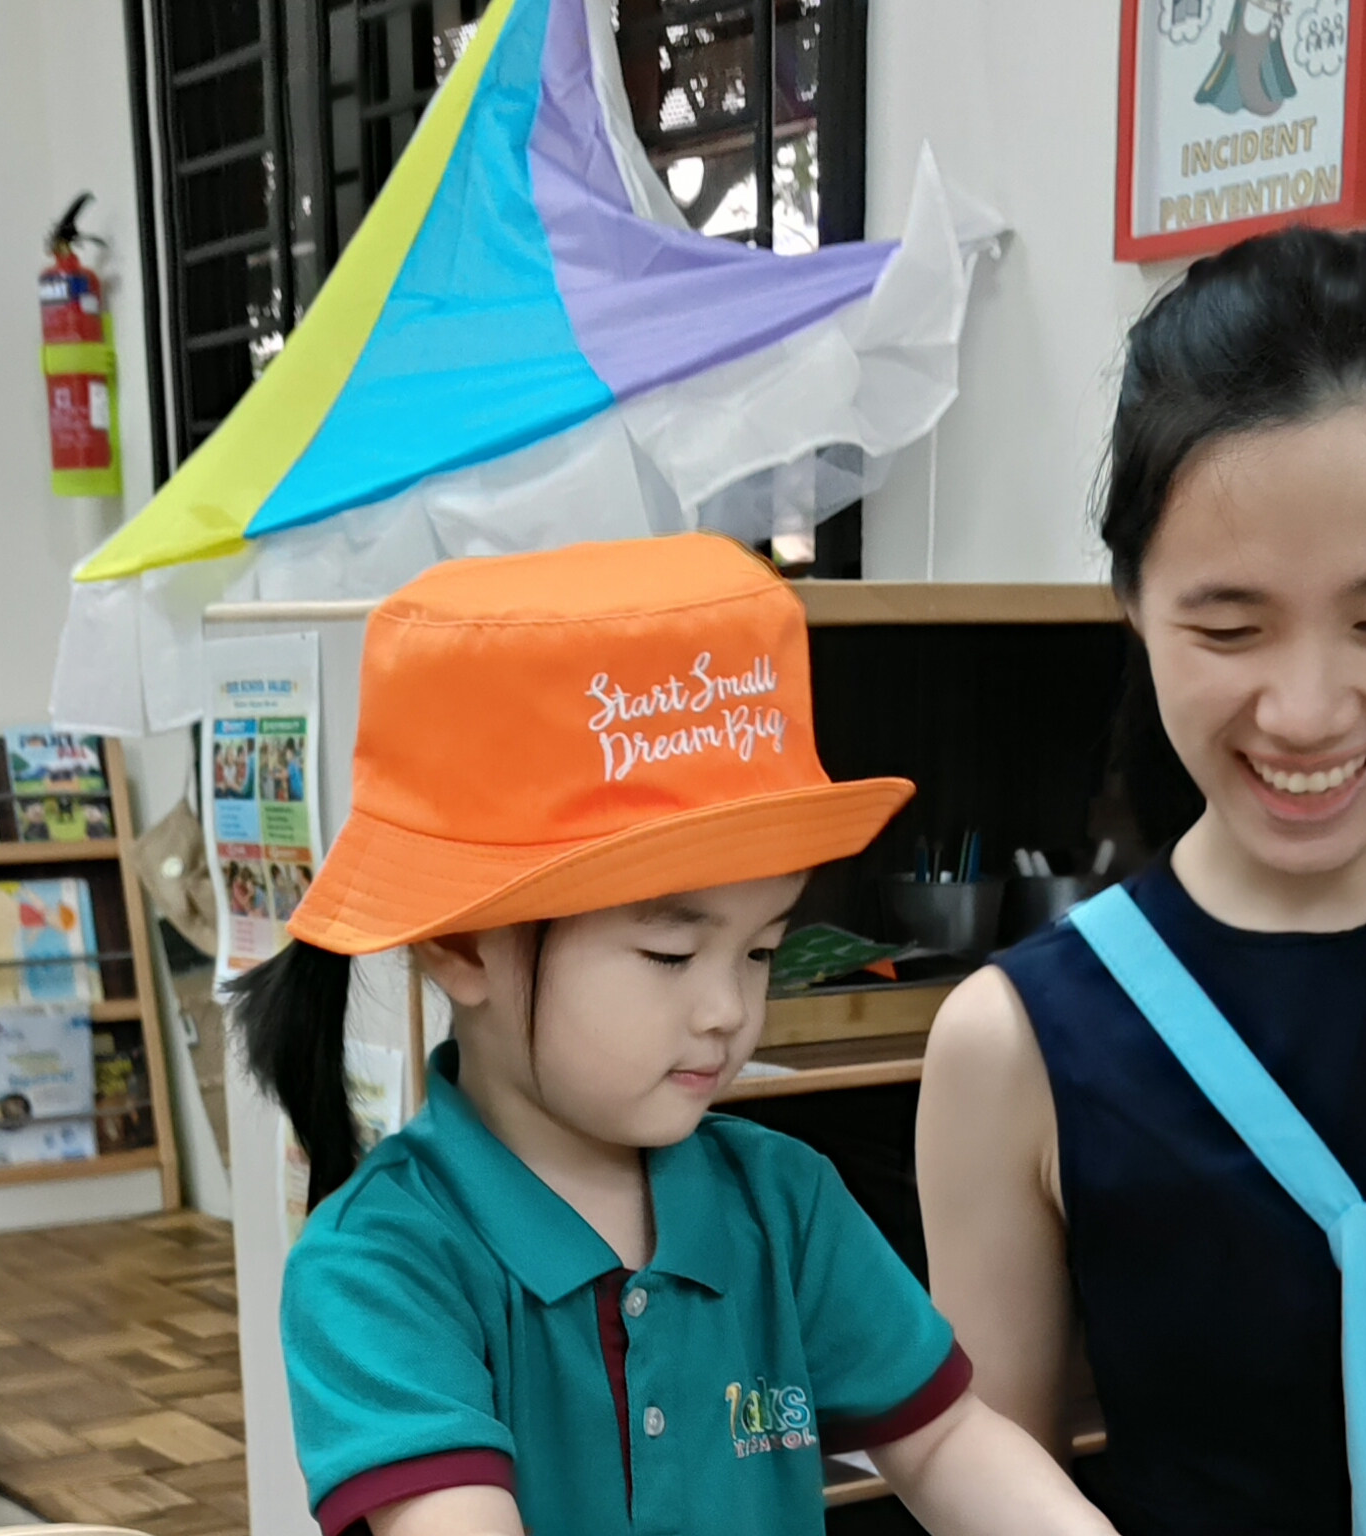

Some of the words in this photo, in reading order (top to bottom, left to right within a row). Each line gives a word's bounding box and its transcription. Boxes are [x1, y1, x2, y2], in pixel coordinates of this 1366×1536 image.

[1181, 116, 1318, 178] INCIDENT
[1159, 164, 1338, 232] PREVENTION
[584, 672, 689, 732] Start
[689, 651, 778, 713] Small
[598, 720, 726, 783] Dream
[722, 704, 788, 762] Big
